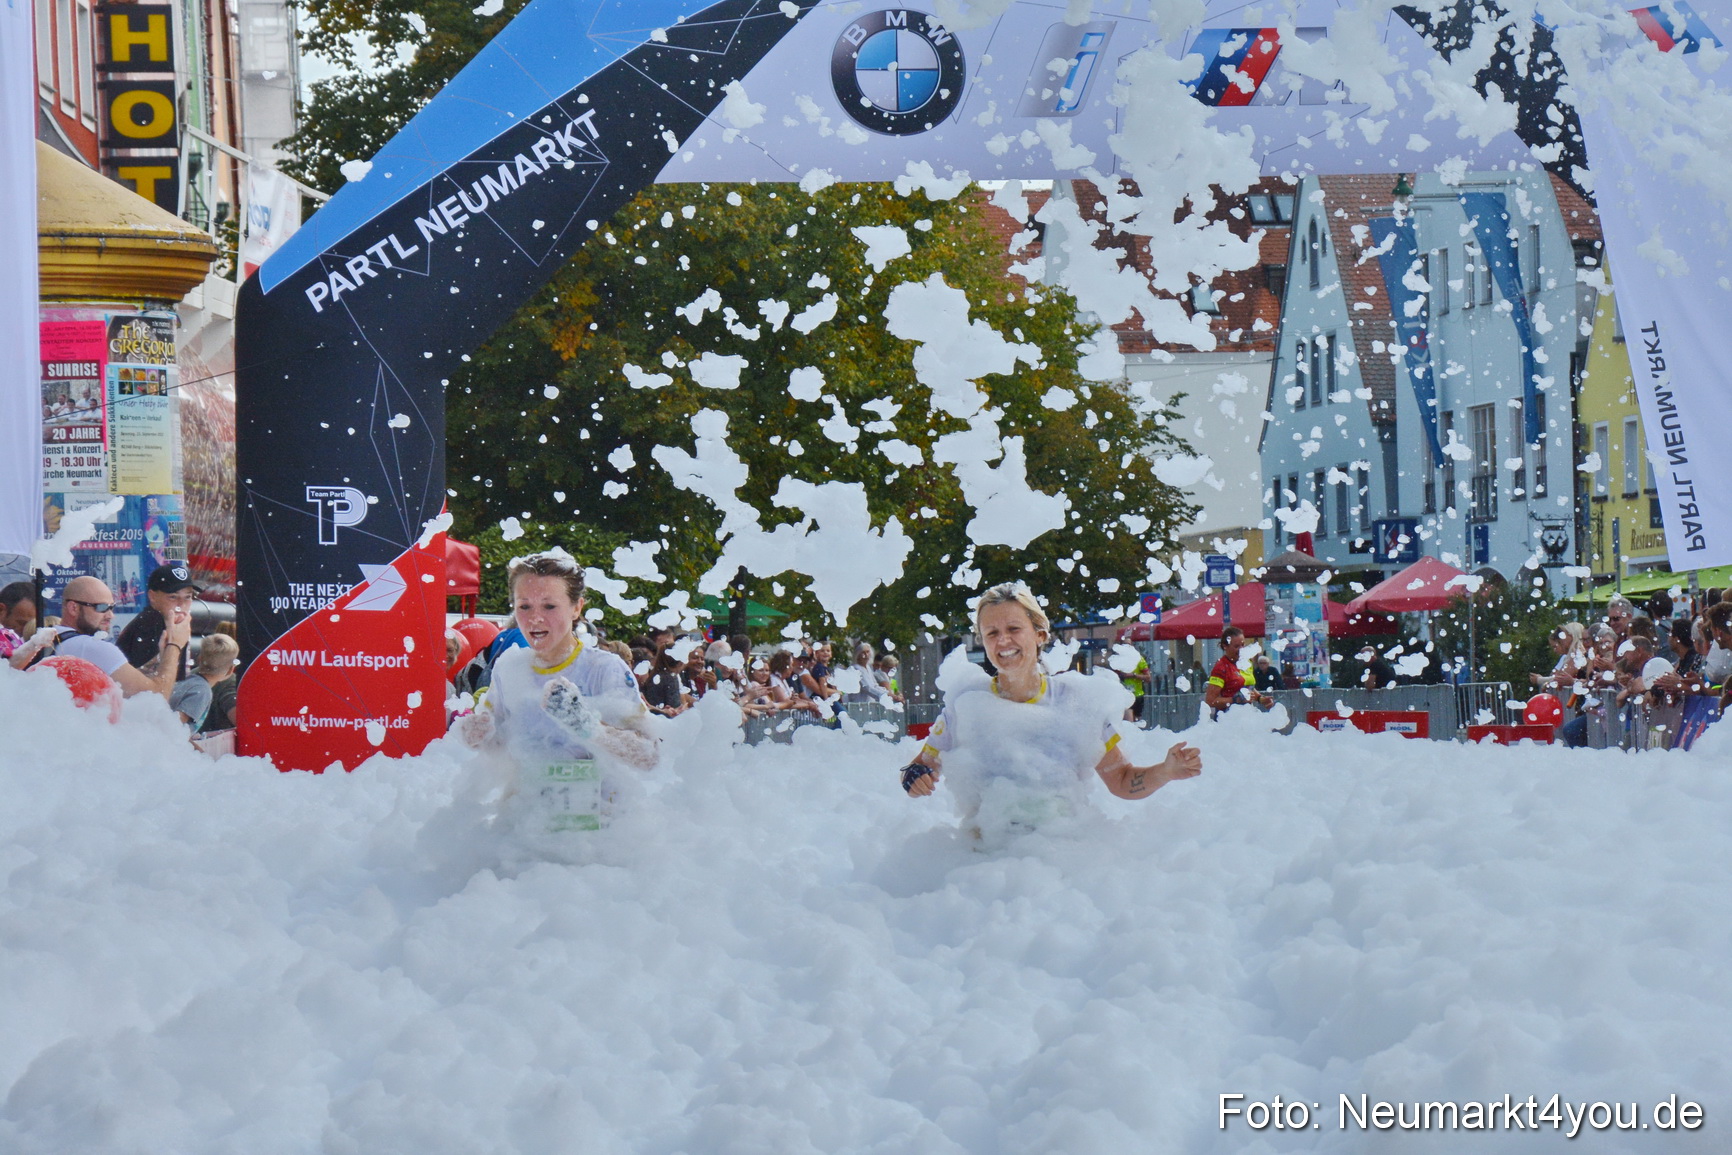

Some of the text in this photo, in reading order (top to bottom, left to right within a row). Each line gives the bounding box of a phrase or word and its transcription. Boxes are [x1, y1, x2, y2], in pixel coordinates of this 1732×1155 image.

[843, 11, 952, 46] BMW
[304, 233, 419, 313] PARTL
[414, 108, 600, 243] NEUMARKT
[121, 319, 150, 343] The
[48, 363, 97, 377] SUNRISE
[53, 428, 100, 440] 20 JAHRE
[73, 445, 101, 454] Konzert
[61, 457, 84, 467] 18.30
[86, 456, 101, 467] Uhr
[67, 469, 102, 478] Neumarkt
[121, 528, 144, 541] 2019
[55, 577, 65, 585] 20
[288, 583, 353, 597] THE NEXT
[269, 596, 336, 610] 100 YEARS
[269, 649, 410, 671] BMW Laufsport
